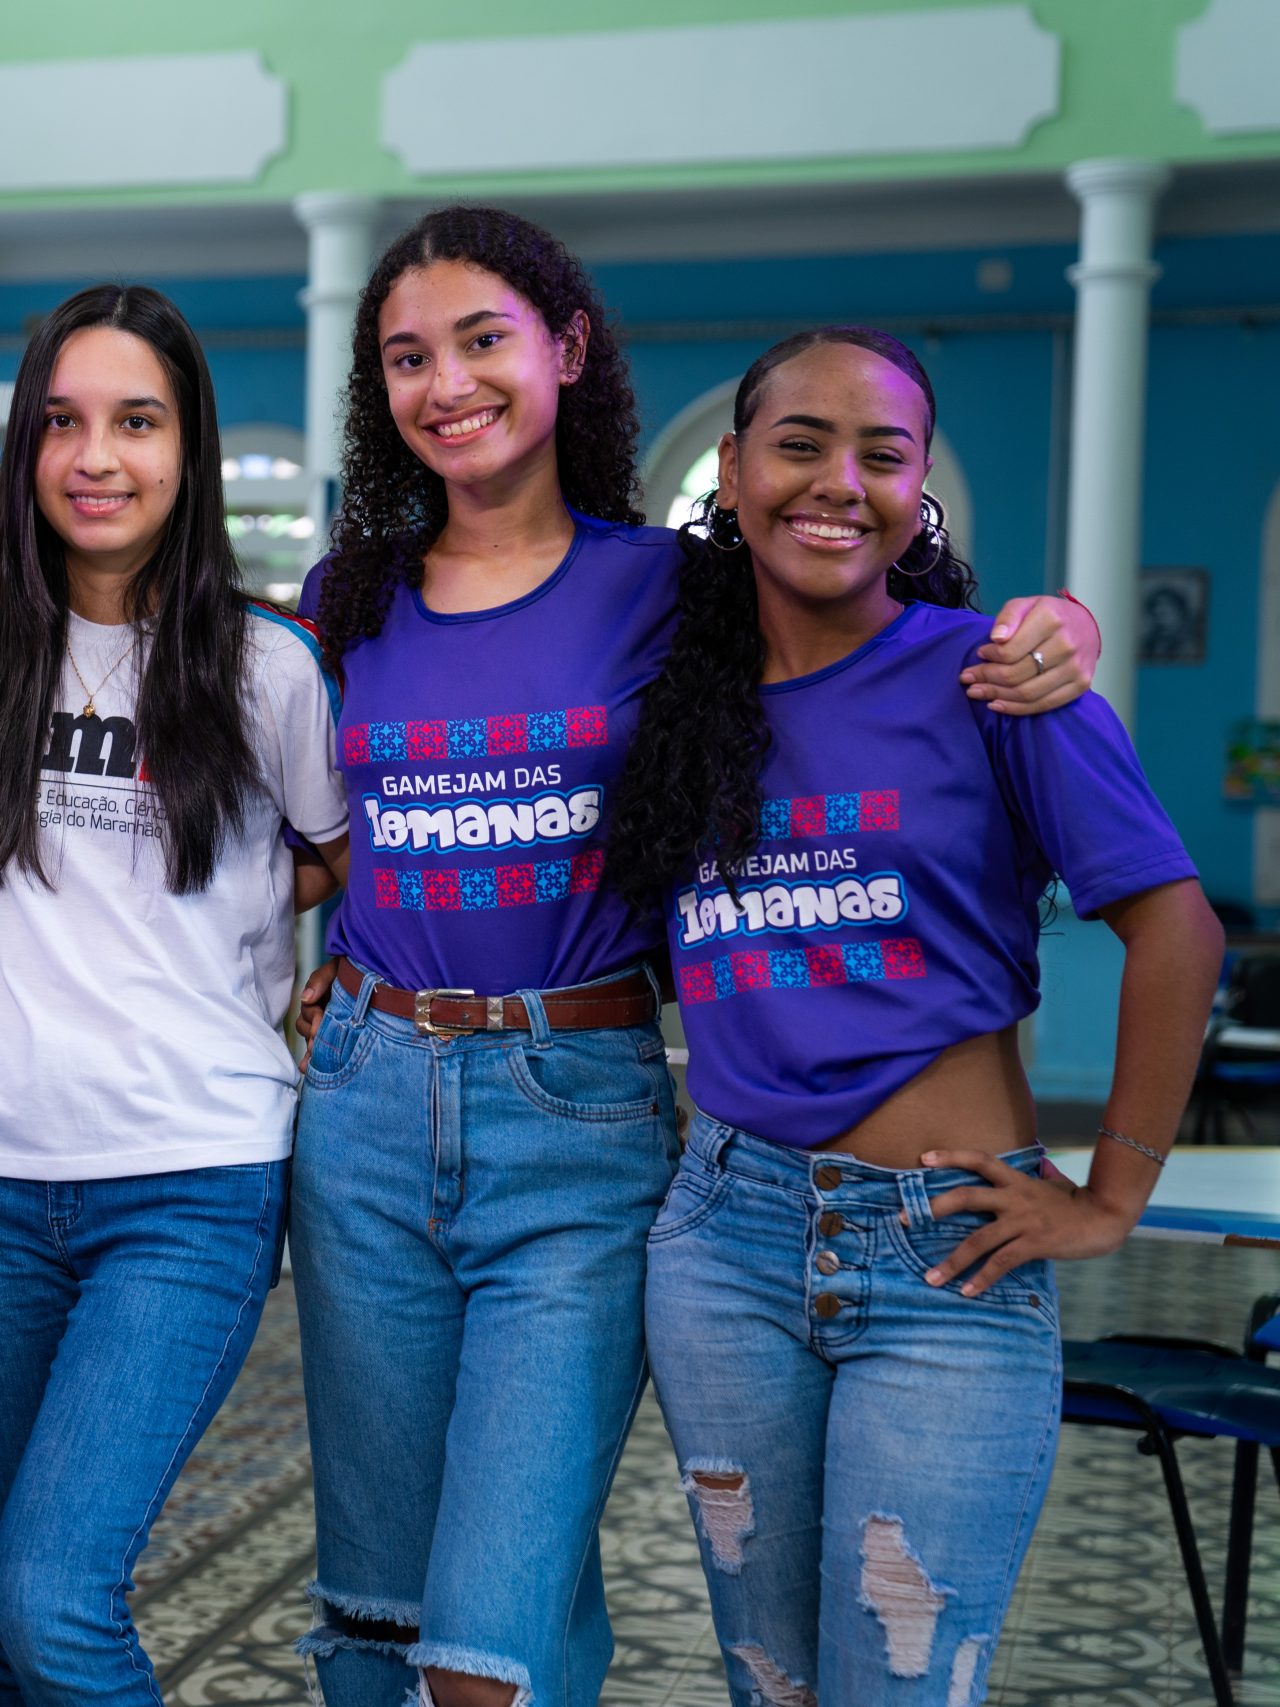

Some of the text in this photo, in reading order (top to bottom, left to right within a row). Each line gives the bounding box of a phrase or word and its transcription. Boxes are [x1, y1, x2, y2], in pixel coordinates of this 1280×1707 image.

[382, 764, 562, 796] GAMEJAM DAS
[46, 789, 119, 815] Educação,
[66, 810, 85, 828] do
[90, 813, 163, 839] Maranhão
[815, 848, 857, 872] DAS
